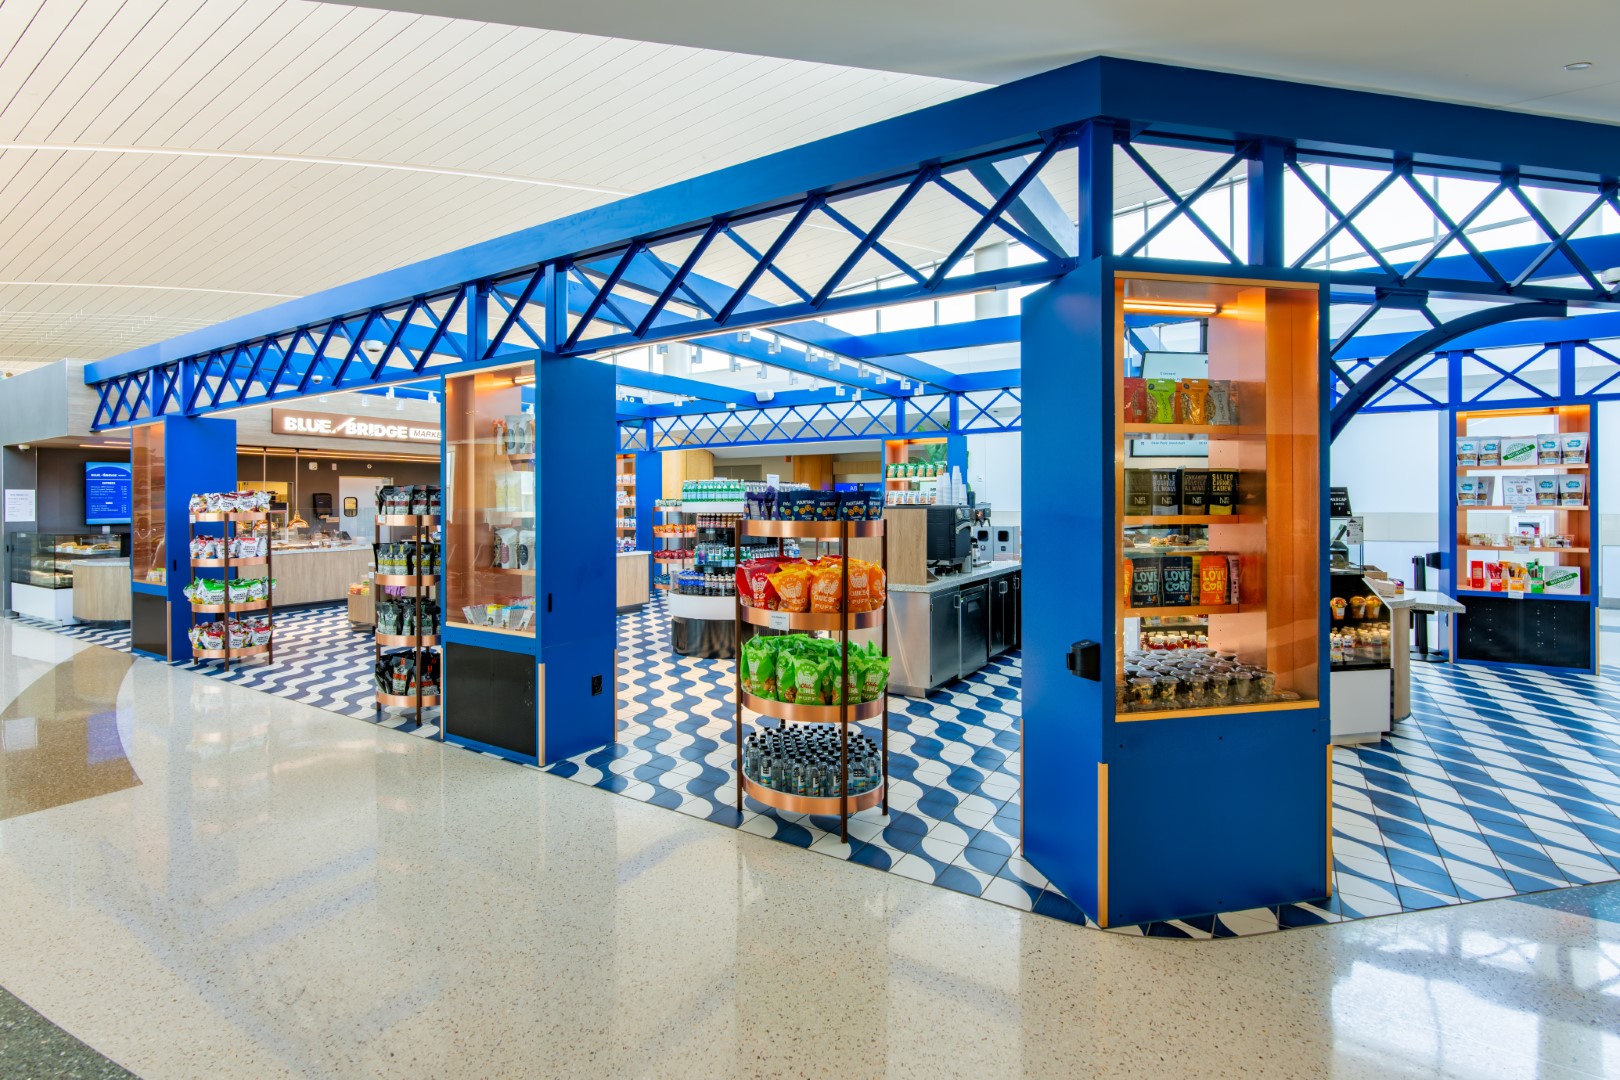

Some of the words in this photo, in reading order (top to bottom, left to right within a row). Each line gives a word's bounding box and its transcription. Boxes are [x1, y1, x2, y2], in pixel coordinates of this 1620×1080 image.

[284, 416, 332, 433] BLUE
[345, 418, 408, 438] BRIDGE
[413, 429, 441, 439] MARKE
[1133, 571, 1160, 582] LOVE
[1164, 570, 1191, 581] LOVE
[1202, 581, 1224, 592] COR
